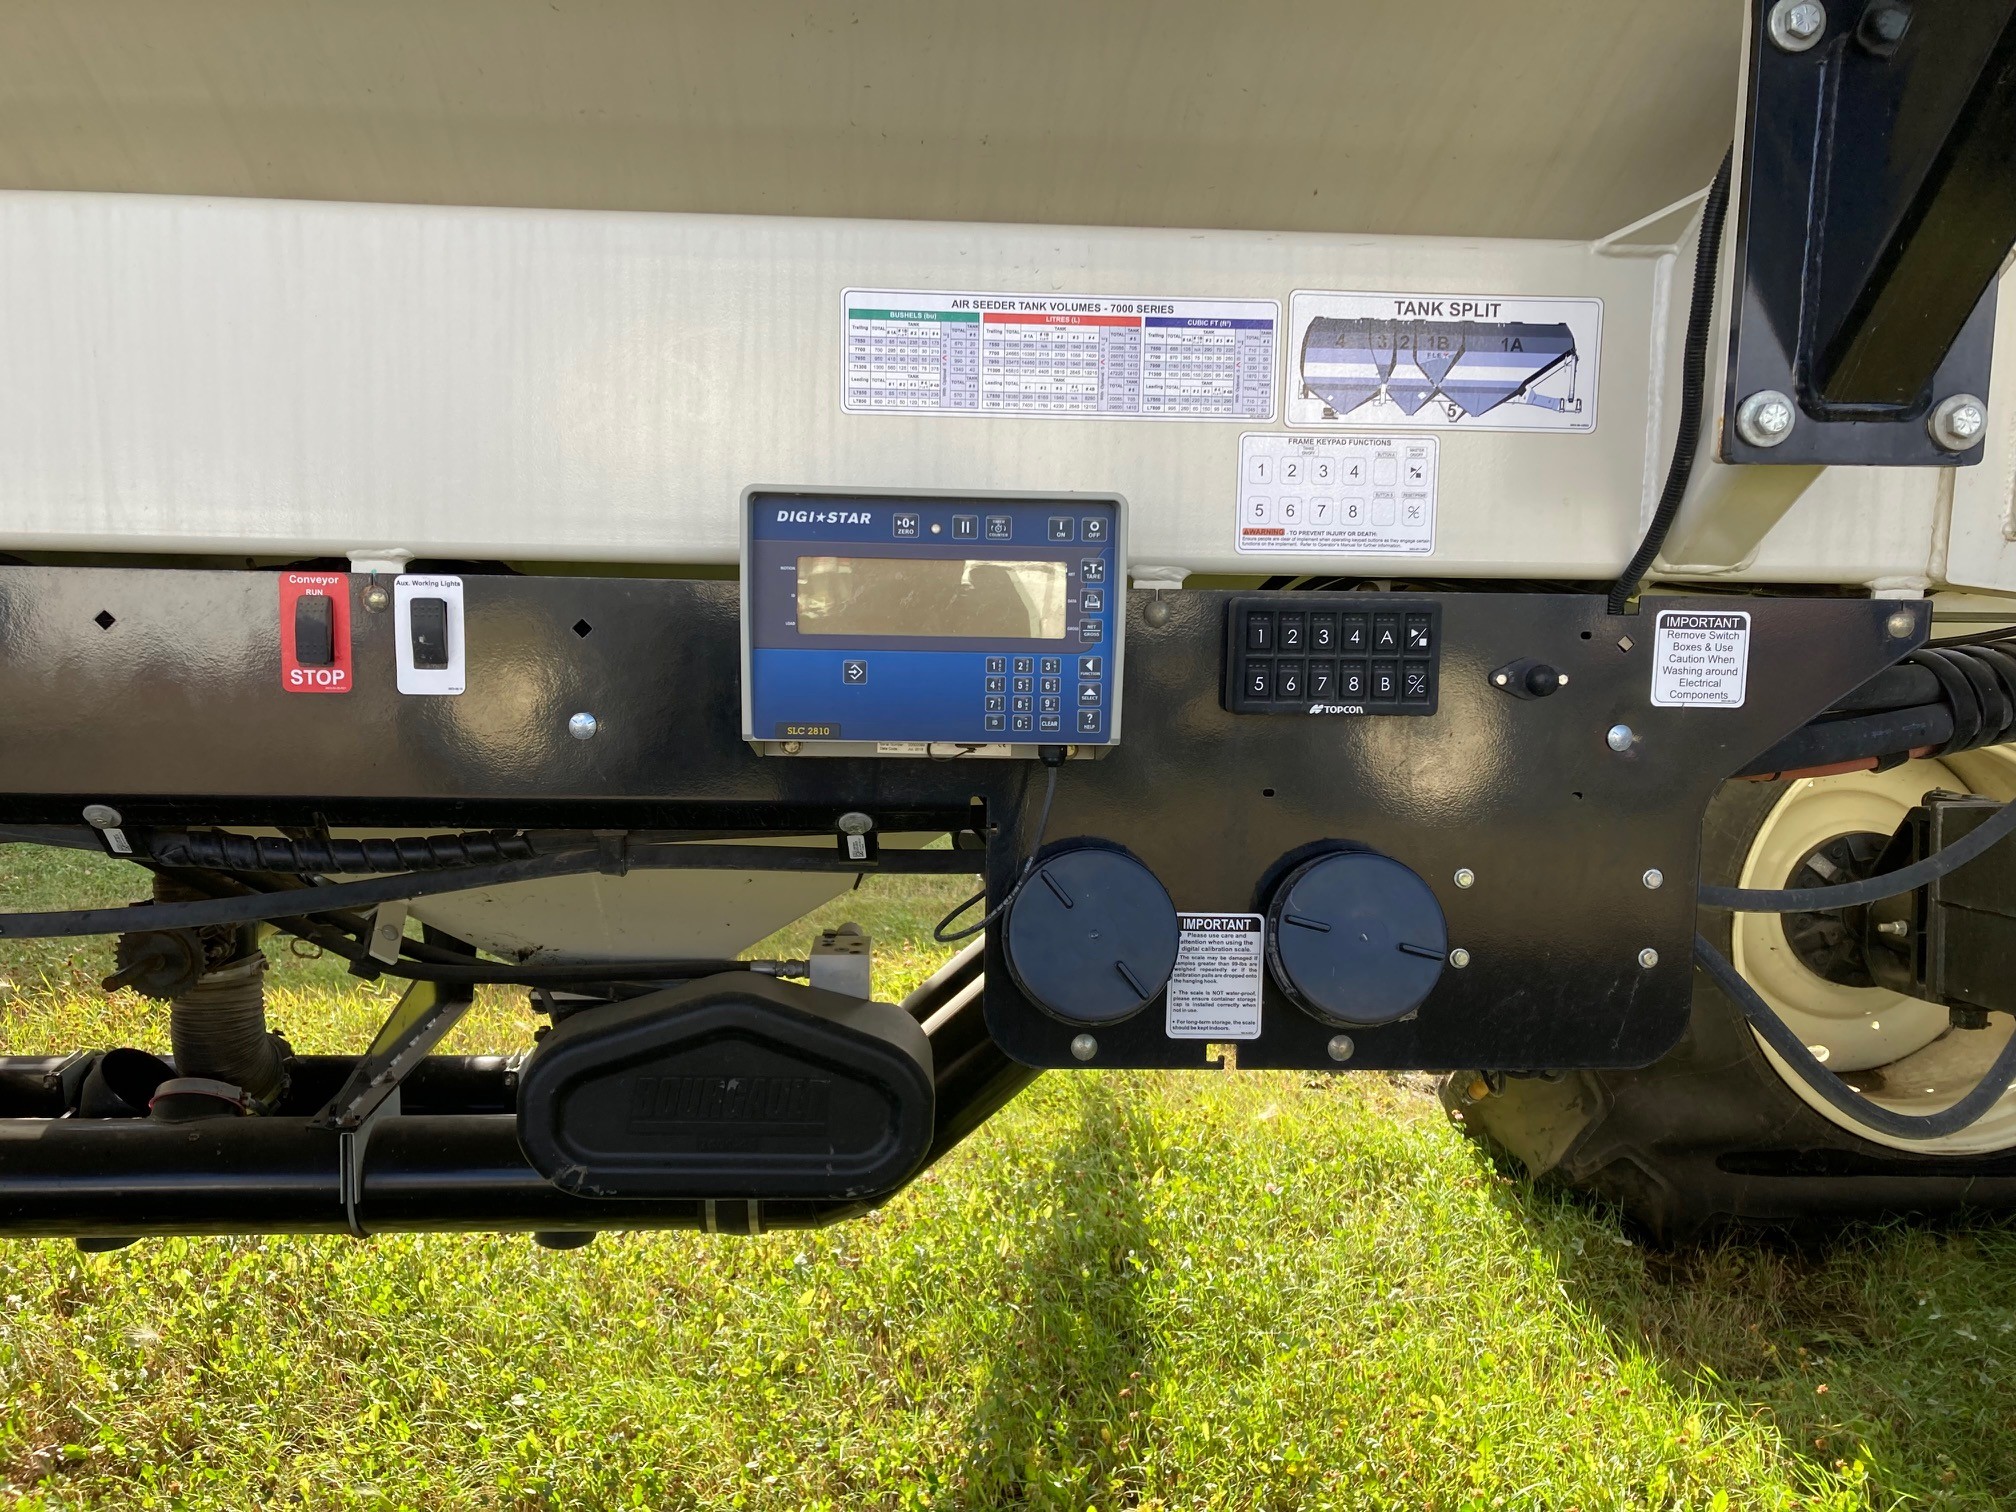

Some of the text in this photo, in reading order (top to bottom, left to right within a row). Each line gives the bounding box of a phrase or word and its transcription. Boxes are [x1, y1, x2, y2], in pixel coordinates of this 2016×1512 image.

[951, 299, 970, 310] AIR
[973, 300, 1016, 312] SEEDER
[1019, 302, 1047, 312] TANK
[1050, 302, 1102, 313] VOLUMES
[1111, 304, 1134, 314] 7000
[1135, 304, 1174, 315] SERIES
[1394, 301, 1501, 318] TANK SPLIT
[1335, 334, 1345, 348] 4
[1378, 335, 1387, 348] 3
[1400, 336, 1409, 349] 2
[1427, 336, 1449, 349] 1B
[1502, 338, 1523, 352] 1A
[1447, 404, 1456, 418] 5
[1258, 464, 1264, 476] 1
[1288, 464, 1296, 477] 2
[1319, 465, 1328, 477] 3
[1350, 465, 1359, 478] 4
[1255, 504, 1264, 517] 5
[1286, 504, 1294, 517] 6
[1318, 505, 1326, 517] 7
[1349, 505, 1357, 518] 8
[1090, 564, 1097, 573] T
[289, 575, 338, 584] Conveyor
[1667, 617, 1740, 628] IMPORTANT
[1258, 629, 1263, 643] 1
[1287, 630, 1298, 644] 2
[1319, 630, 1329, 644] 3
[1350, 630, 1360, 643] 4
[1381, 630, 1393, 644] A
[1667, 630, 1739, 640] Remove Switch
[1673, 642, 1733, 652] Boxes & Use
[1669, 654, 1735, 663] Caution When
[1018, 662, 1023, 670] 2
[1045, 662, 1050, 670] 3
[1663, 666, 1738, 677] Washing around
[291, 669, 345, 685] STOP
[1679, 678, 1721, 687] Electrical
[990, 681, 995, 689] 4
[1018, 681, 1022, 689] 5
[1045, 681, 1050, 689] 6
[1254, 677, 1264, 691] 5
[1286, 677, 1296, 691] 6
[1318, 677, 1328, 691] 7
[1349, 677, 1359, 691] 8
[1381, 678, 1390, 691] B
[1670, 690, 1728, 700] Components
[1017, 700, 1022, 708] 8
[1324, 705, 1363, 714] TOPCON
[808, 727, 829, 735] 2810
[1183, 919, 1251, 930] IMPORTANT
